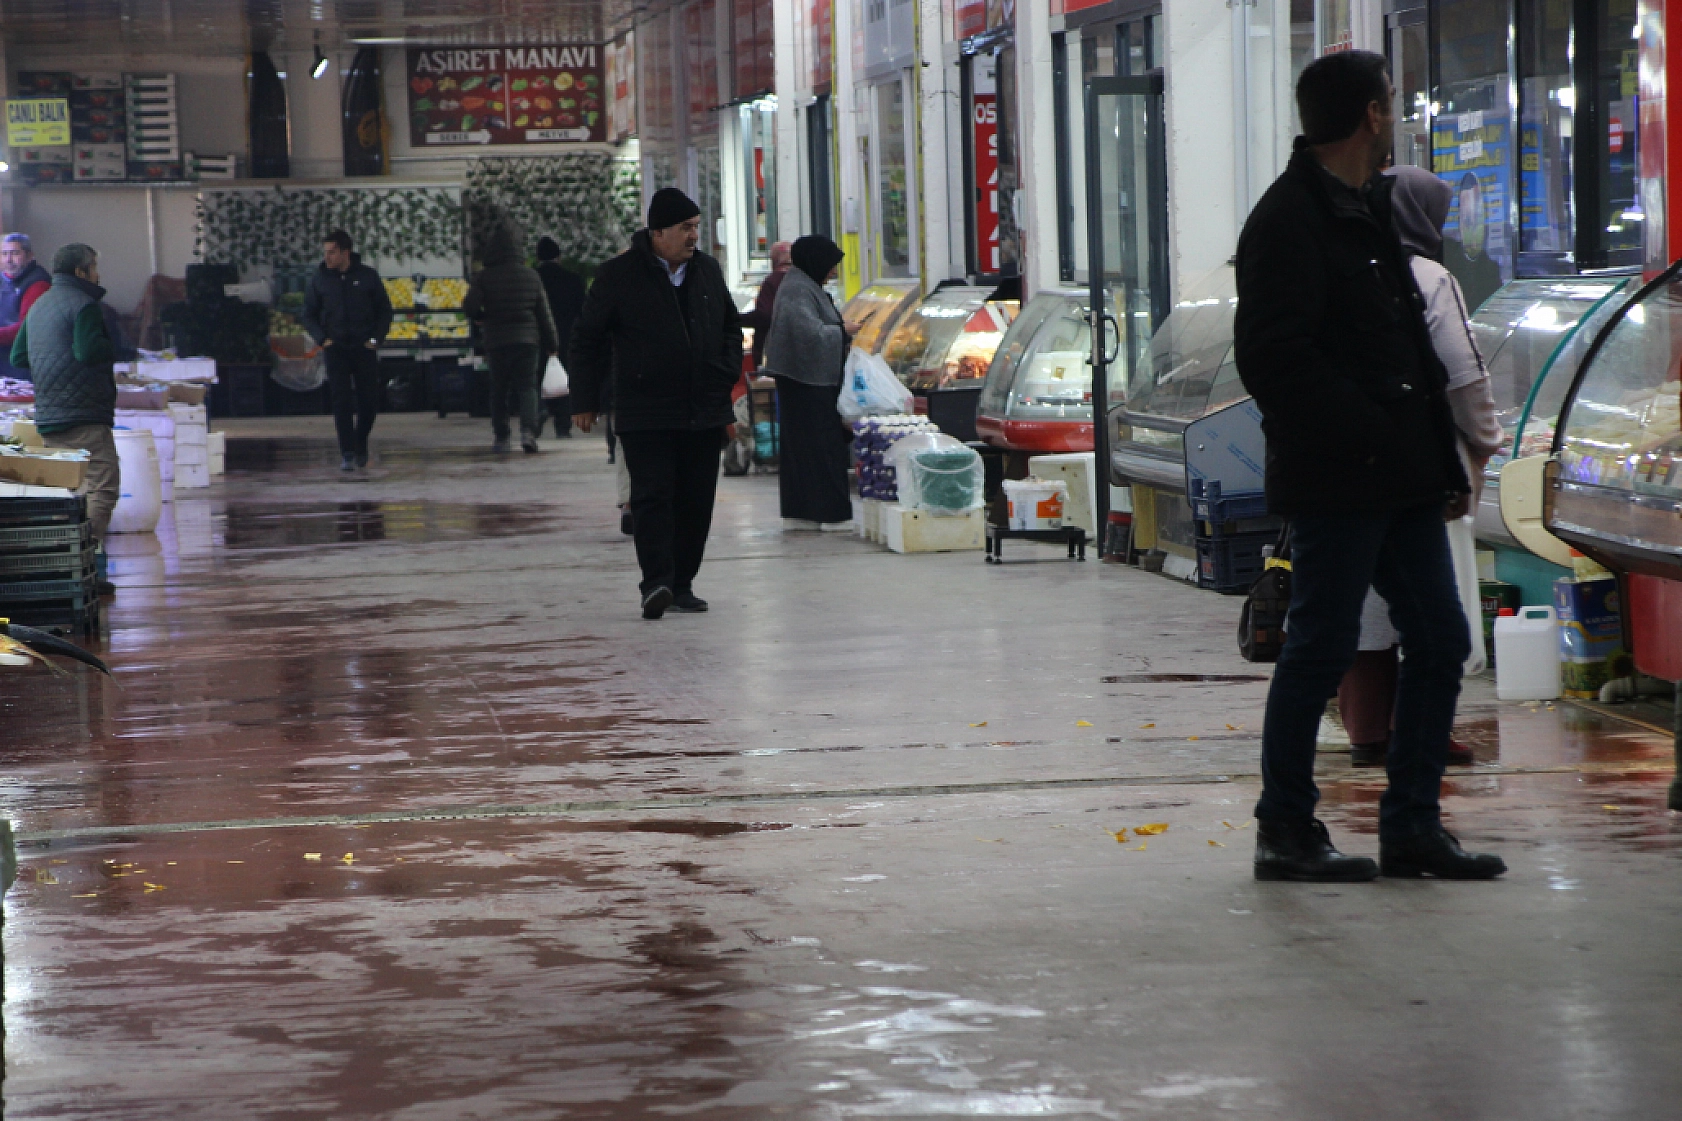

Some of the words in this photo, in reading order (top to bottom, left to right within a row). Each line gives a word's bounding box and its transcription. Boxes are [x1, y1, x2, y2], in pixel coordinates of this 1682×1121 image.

[505, 46, 597, 71] MANAVI
[8, 102, 37, 124] CANLI
[38, 102, 66, 122] BALIK
